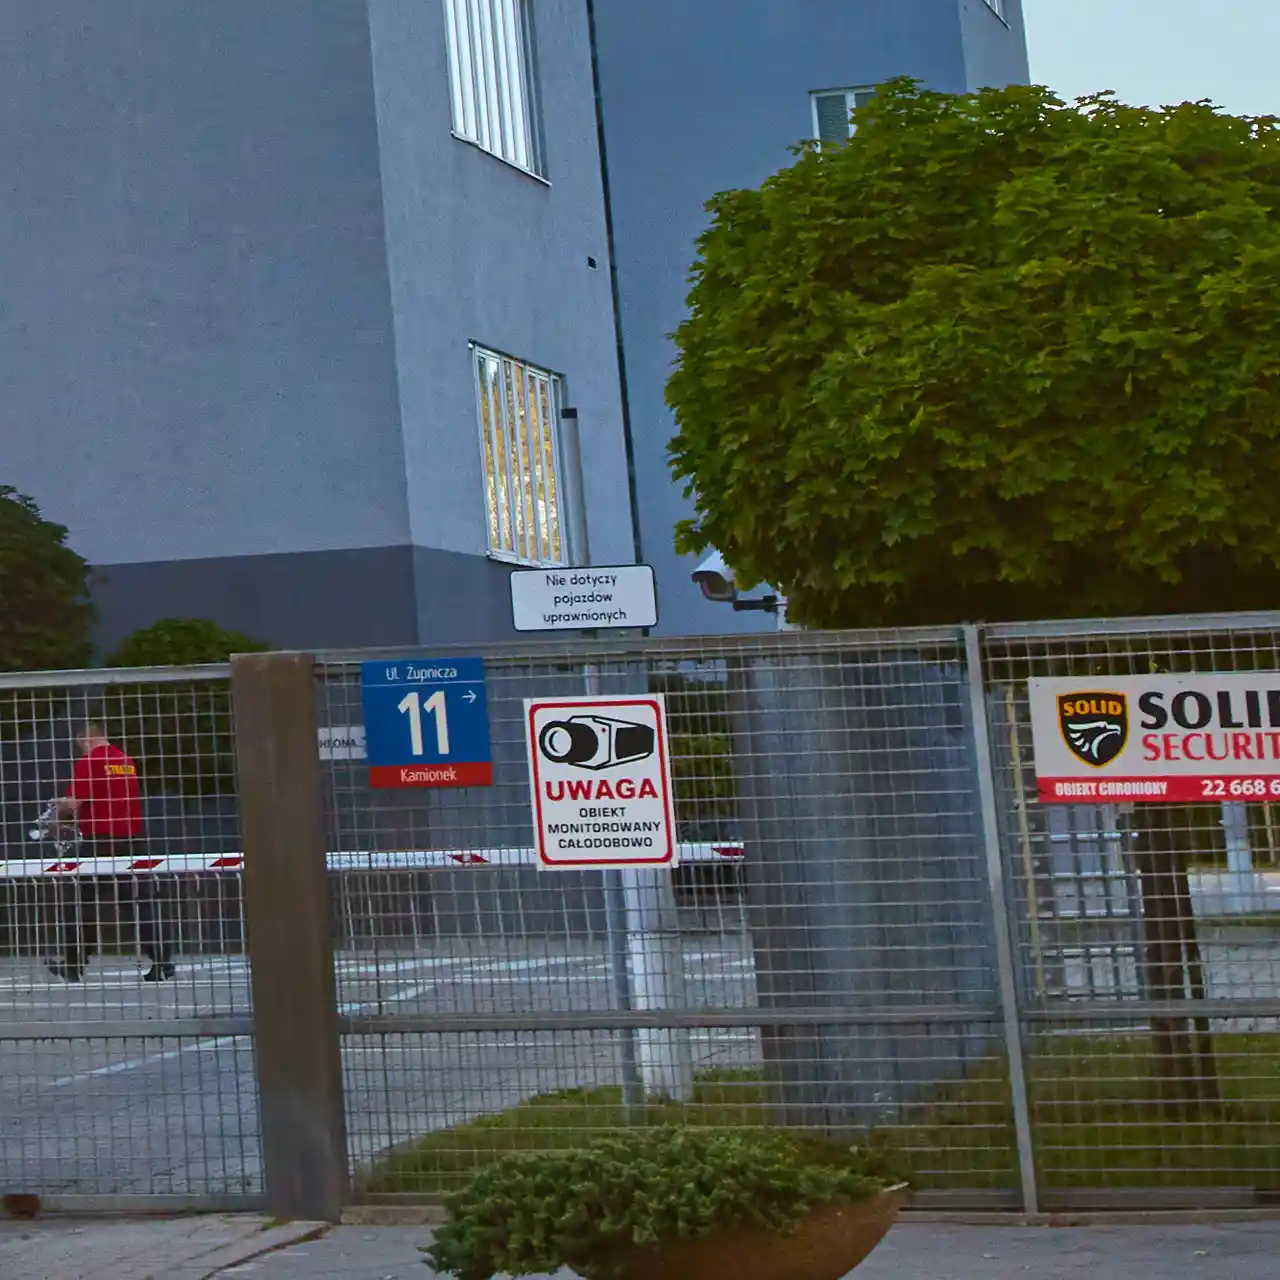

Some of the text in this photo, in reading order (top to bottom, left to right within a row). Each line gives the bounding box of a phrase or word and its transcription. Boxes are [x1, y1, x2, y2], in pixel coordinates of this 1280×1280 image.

[546, 573, 617, 587] Nie dotyczy
[543, 608, 627, 625] uprawnionych
[1063, 700, 1123, 717] SOLID
[397, 690, 450, 756] 11
[400, 766, 457, 783] Kamionek
[545, 778, 659, 801] UWAGA
[1202, 780, 1225, 796] 22
[1230, 779, 1266, 796] 668
[579, 806, 627, 818] OBIEKT
[547, 821, 661, 834] MONITOROWANY
[558, 837, 653, 849] CAŁODOBOWO
